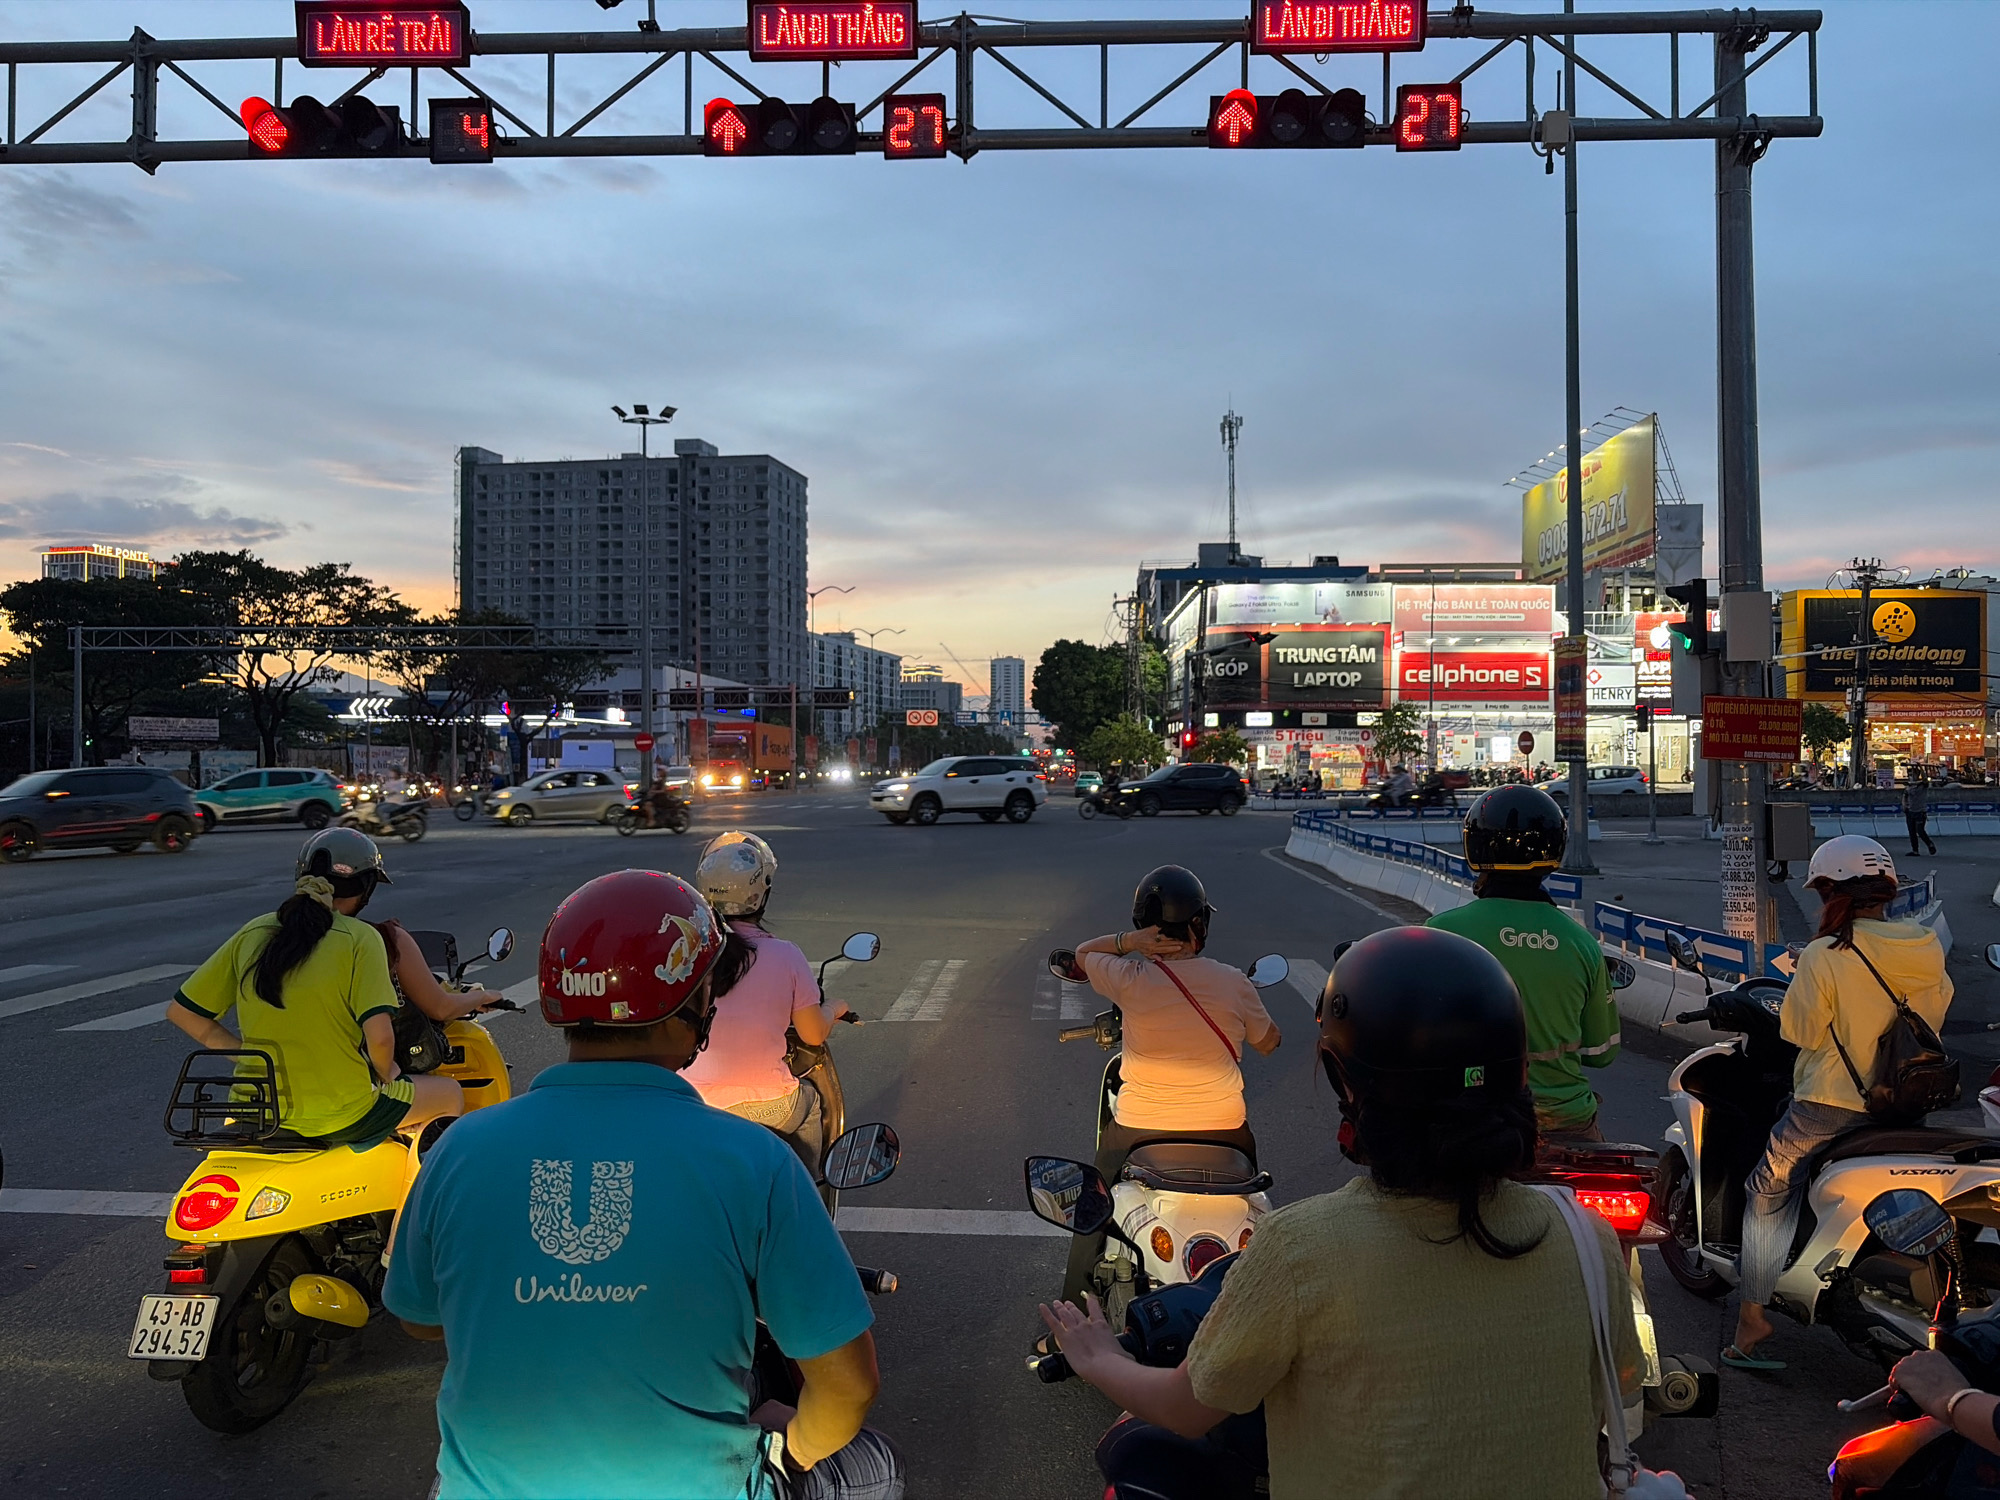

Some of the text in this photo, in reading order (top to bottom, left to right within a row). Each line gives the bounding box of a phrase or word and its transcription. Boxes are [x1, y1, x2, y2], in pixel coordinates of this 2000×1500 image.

[760, 7, 806, 45] LÀN
[808, 13, 828, 45] ĐI
[1264, 0, 1310, 38] LÀN
[1313, 6, 1334, 38] ĐI
[316, 11, 452, 52] LÀN RẼ TRÁI
[889, 106, 942, 148] 27
[1402, 94, 1457, 142] 27
[463, 114, 488, 148] 4
[92, 543, 113, 556] THE
[115, 547, 149, 561] PONTE
[1396, 599, 1411, 611] HỆ
[1451, 599, 1473, 610] BÁN
[1490, 598, 1518, 610] TOÀN
[1520, 597, 1550, 610] QUỐC
[1276, 644, 1376, 664] TRUNG TÂM
[1821, 645, 1966, 665] theioididong
[1214, 658, 1249, 677] GÓP
[1293, 671, 1362, 688] LAPTOP
[1867, 674, 1888, 688] IỆN
[1890, 674, 1918, 688] ĐIỆN
[1919, 676, 1954, 688] THOẠI
[1592, 688, 1632, 700] HENRY
[1275, 730, 1324, 744] 5 Triệu
[1499, 927, 1559, 951] Grab
[561, 971, 606, 997] OMO
[1889, 1168, 1958, 1176] VISION
[320, 1185, 368, 1204] SCOOPY
[515, 1272, 647, 1303] Unilever
[149, 1300, 205, 1326] 43-AB
[134, 1329, 205, 1356] 294.52
